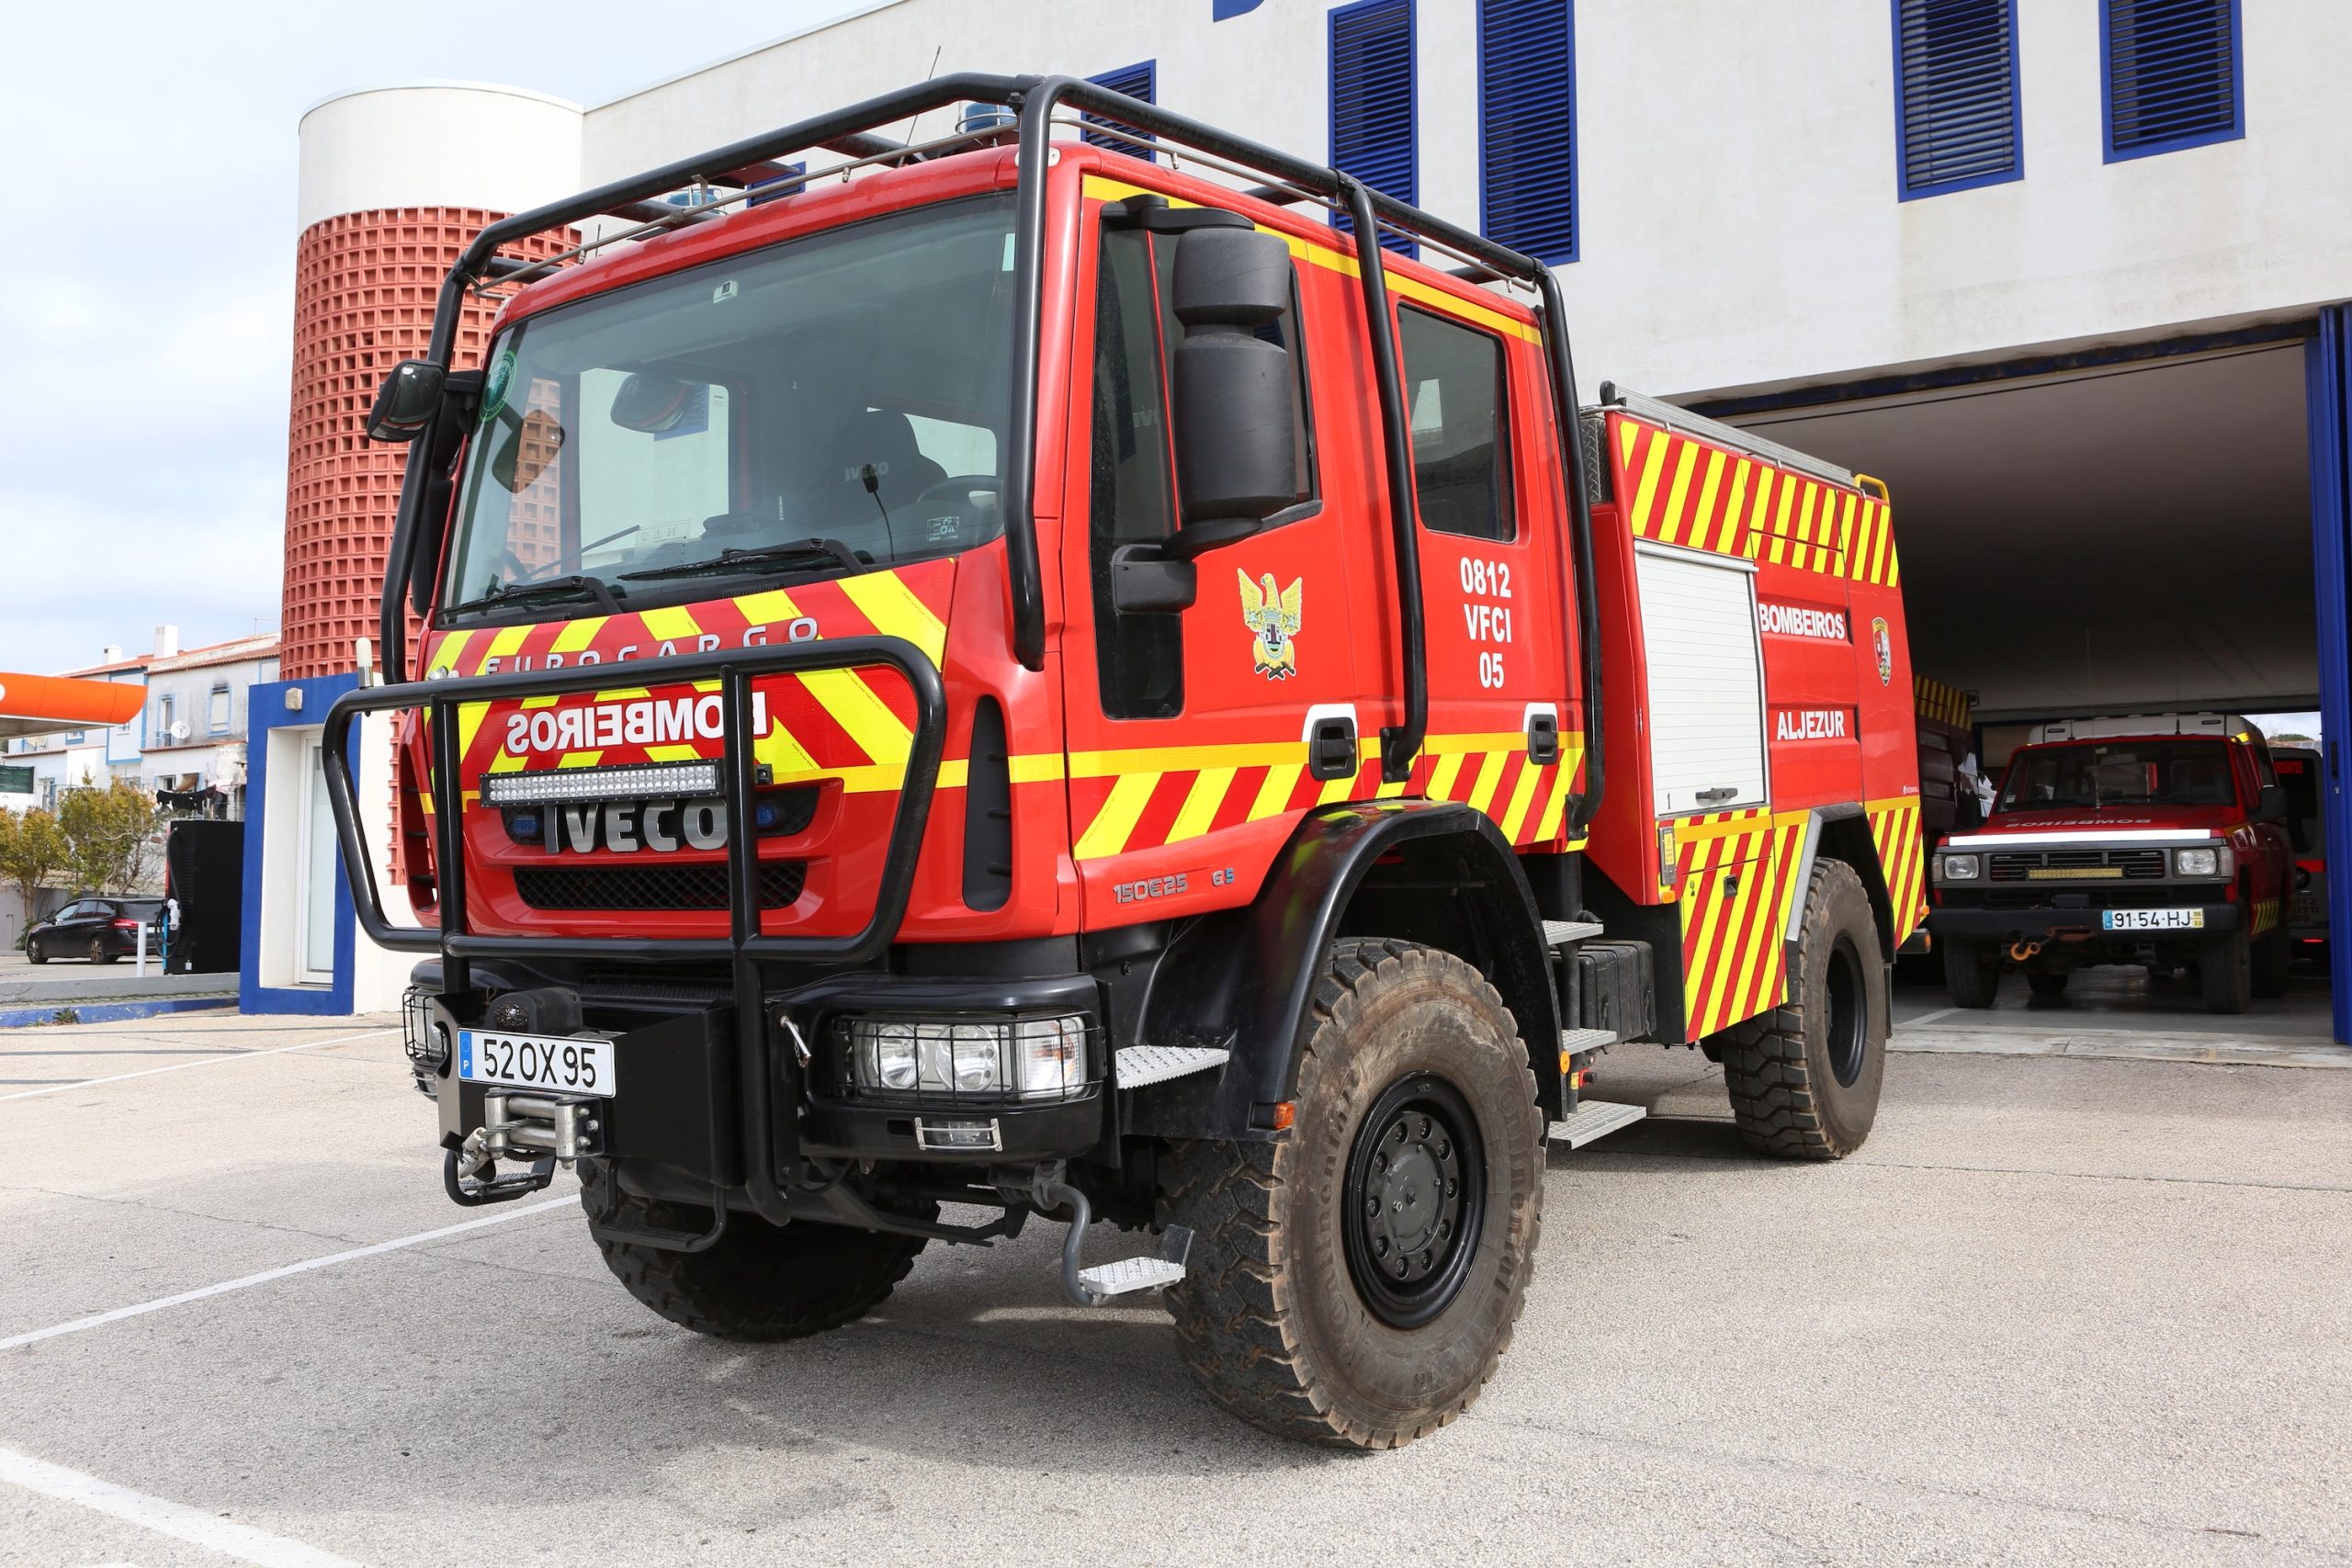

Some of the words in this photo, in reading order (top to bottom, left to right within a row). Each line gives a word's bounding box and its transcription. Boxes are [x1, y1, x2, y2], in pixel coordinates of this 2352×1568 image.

[1460, 557, 1512, 598] 0812
[1464, 604, 1512, 643] VFCI
[1758, 603, 1845, 640] BOMBEIROS
[1479, 651, 1504, 689] 05
[1777, 710, 1845, 740] ALJEZUR
[546, 798, 729, 854] IVECO
[1113, 874, 1188, 903] 150E25
[462, 1059, 469, 1070] P
